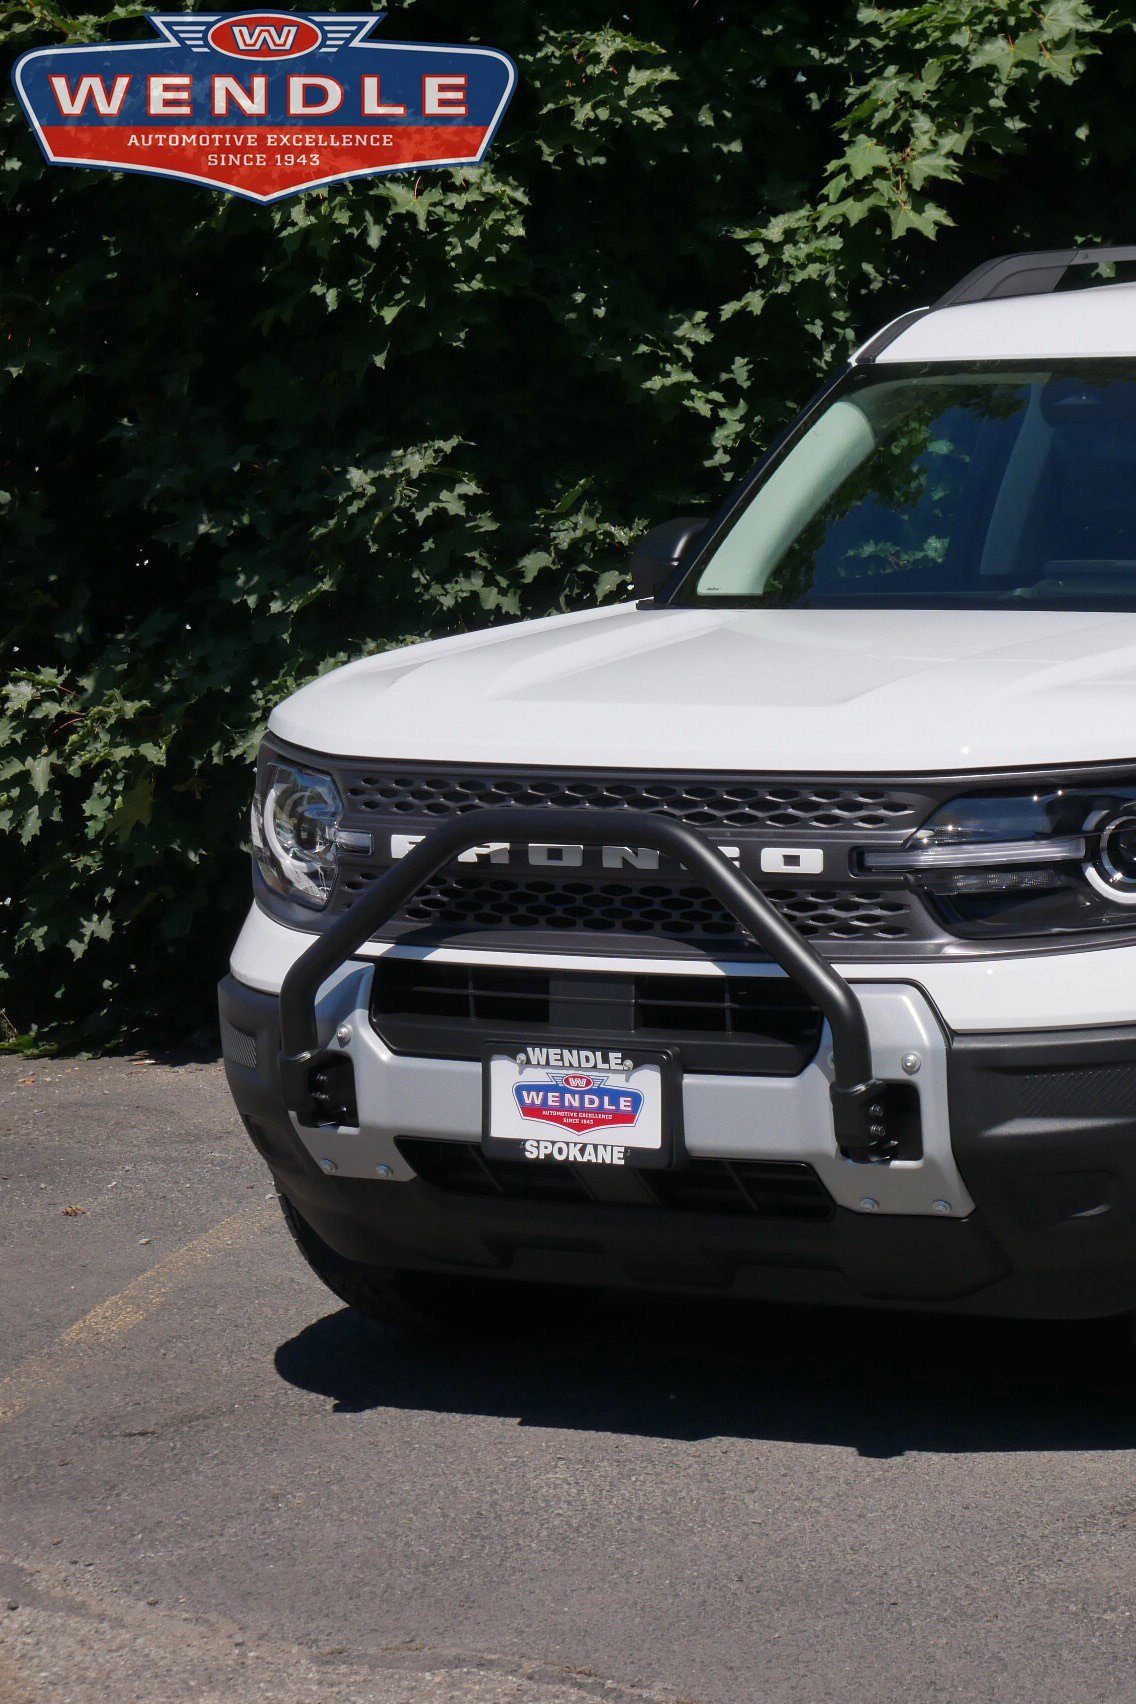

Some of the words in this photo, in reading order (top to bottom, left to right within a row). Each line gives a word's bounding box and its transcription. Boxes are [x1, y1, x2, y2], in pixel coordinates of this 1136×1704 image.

[526, 1047, 624, 1070] WENDLE
[523, 1090, 632, 1110] WENDLE
[525, 1140, 625, 1164] SPOKANE
